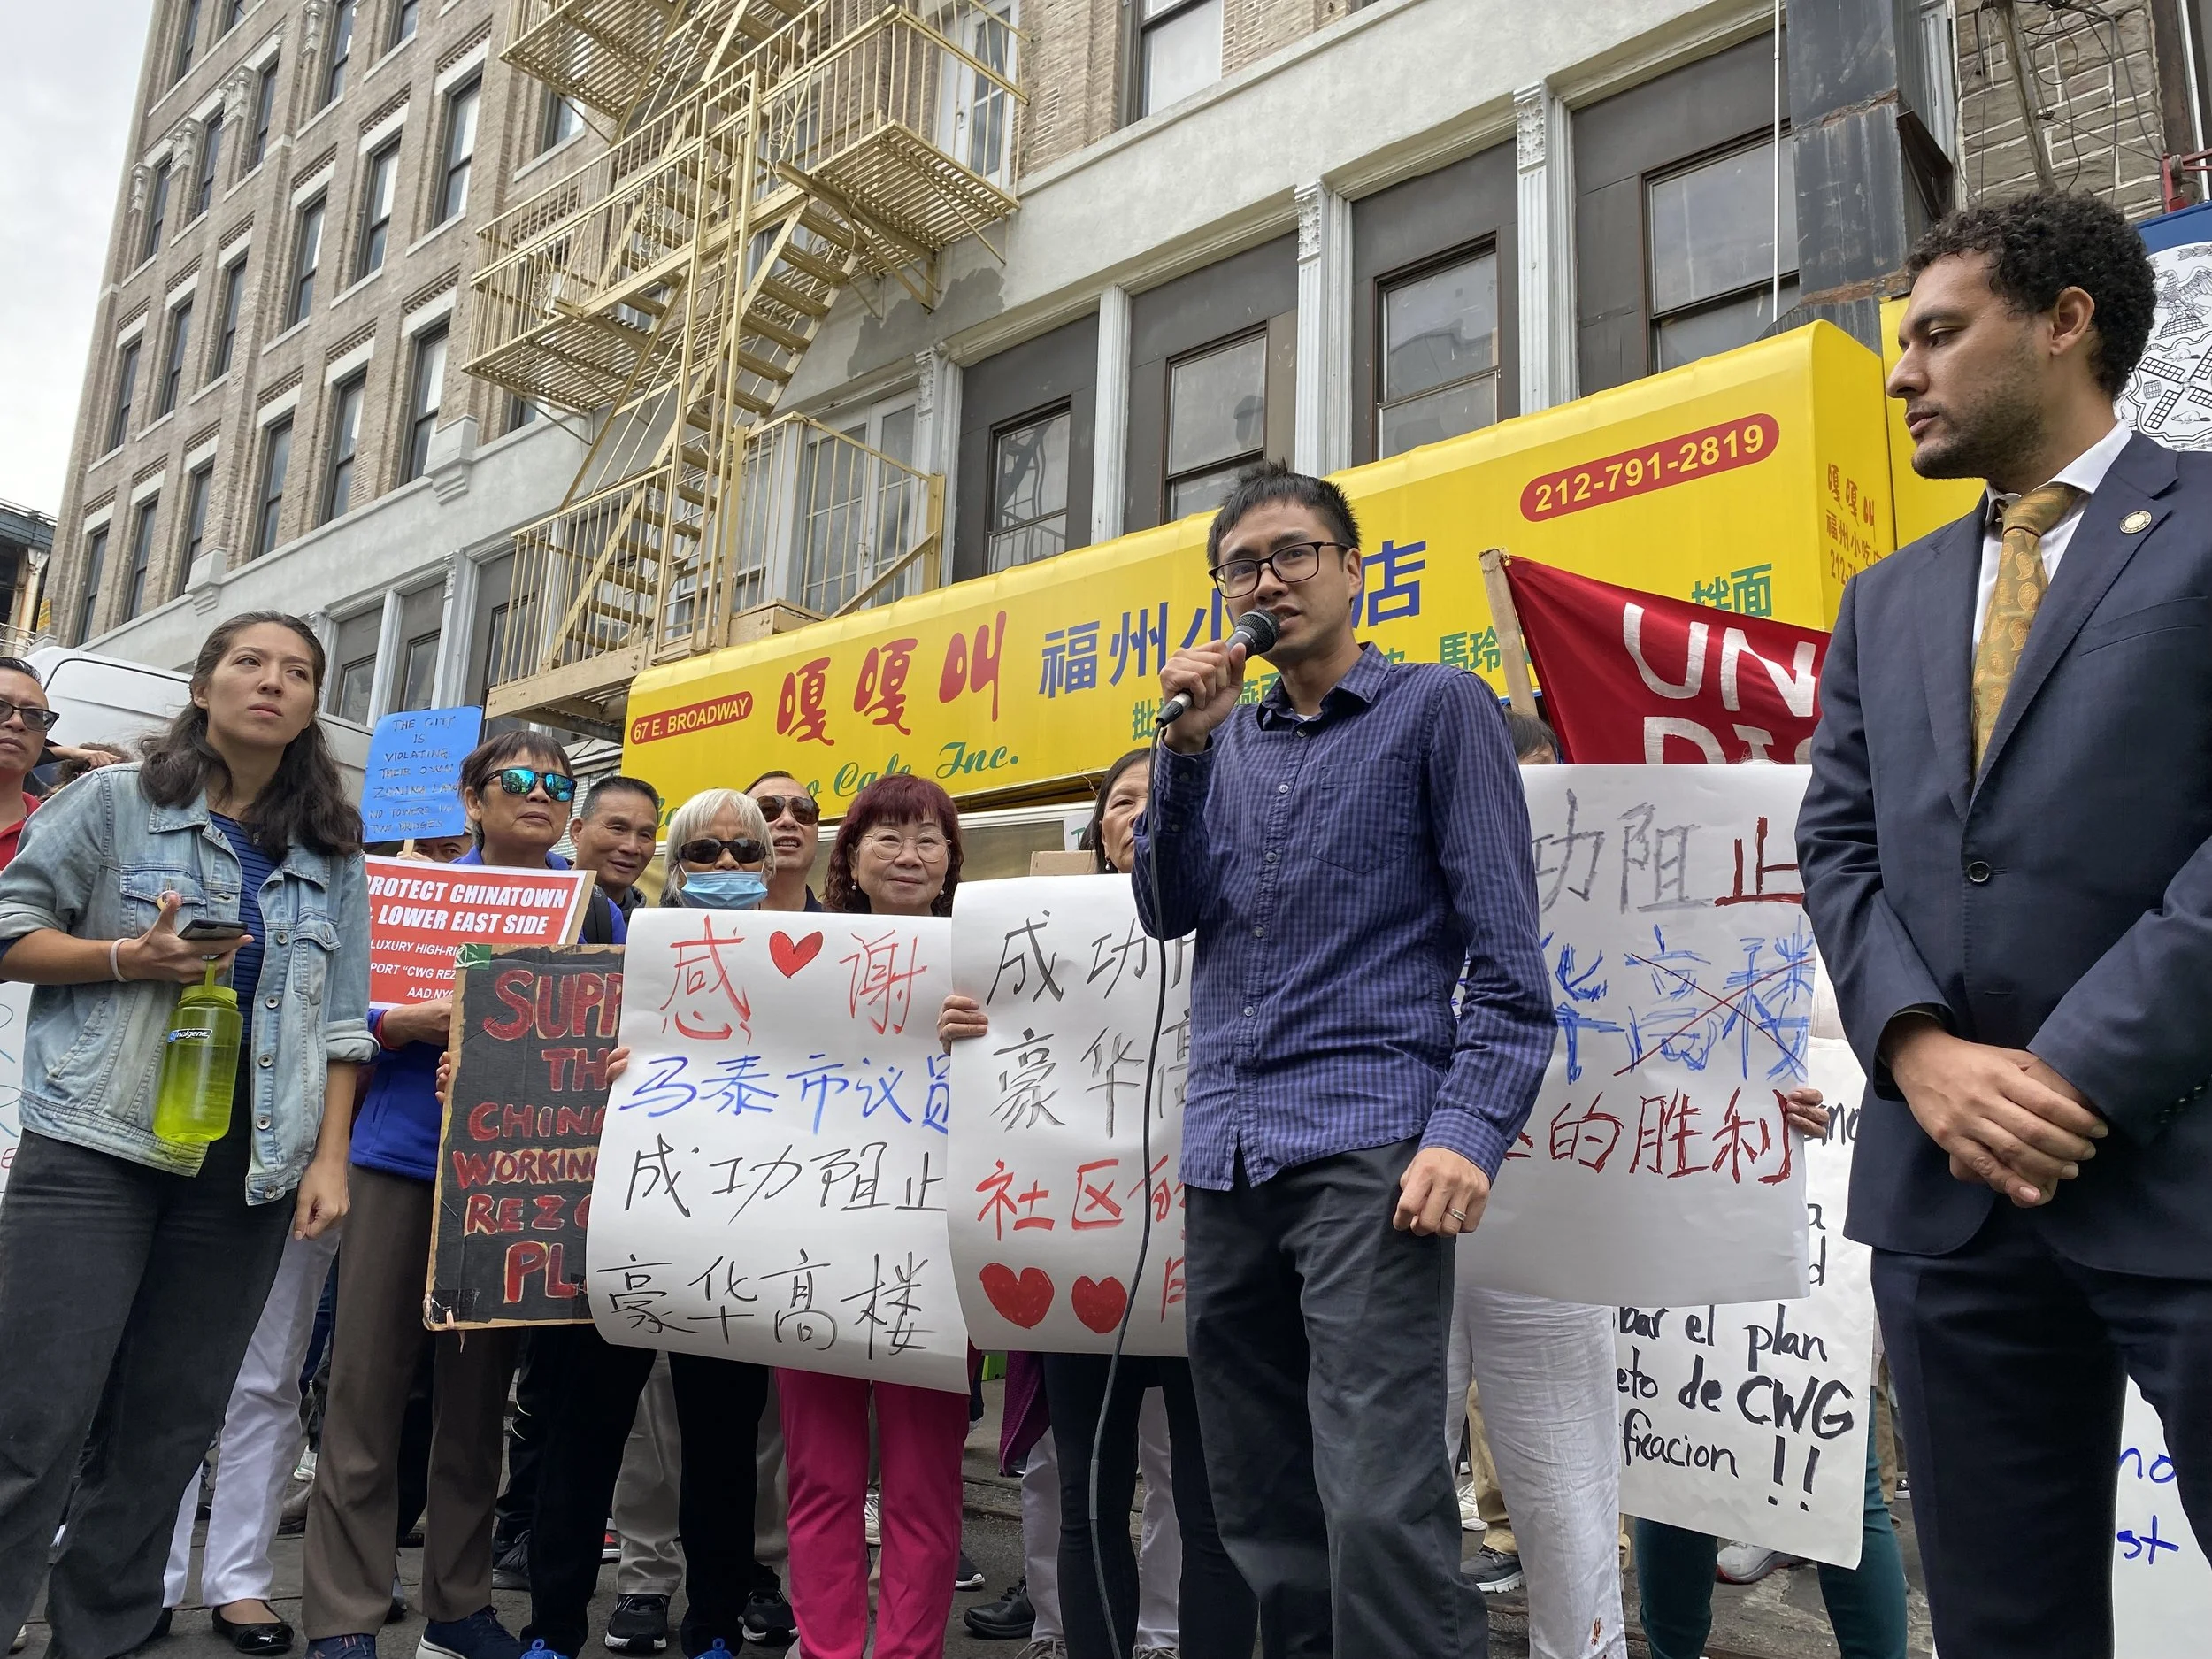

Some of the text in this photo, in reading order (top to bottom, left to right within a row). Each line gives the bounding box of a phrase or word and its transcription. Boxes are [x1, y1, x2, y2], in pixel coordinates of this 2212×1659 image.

[1534, 424, 1764, 513] 212-791-2819
[776, 541, 1427, 746] 嘎嘎叫 福州小店
[393, 716, 456, 732] THE CITY
[413, 733, 426, 743] IS
[634, 695, 749, 741] 67 E. BROADWAY
[379, 767, 411, 779] THEIR
[385, 748, 449, 762] VIOLATING
[936, 741, 1019, 778] Inc.
[370, 810, 383, 819] NO
[391, 806, 430, 818] TOWERS
[367, 875, 569, 909] ROTECT CHINATOWN
[377, 904, 449, 930] LOWER
[450, 911, 502, 933] EAST
[503, 914, 549, 935] SIDE
[371, 938, 414, 952] LUXURY
[986, 910, 1194, 1007] 成功
[660, 914, 928, 1046] 感 谢
[541, 1048, 609, 1092] TH
[1504, 1087, 1793, 1186] 的胜利
[452, 1150, 597, 1189] WORKIN
[624, 1133, 948, 1225] 成功阻止
[1743, 1302, 1828, 1372] plan
[1678, 1354, 1723, 1413] de
[1737, 1375, 1855, 1440] CWG
